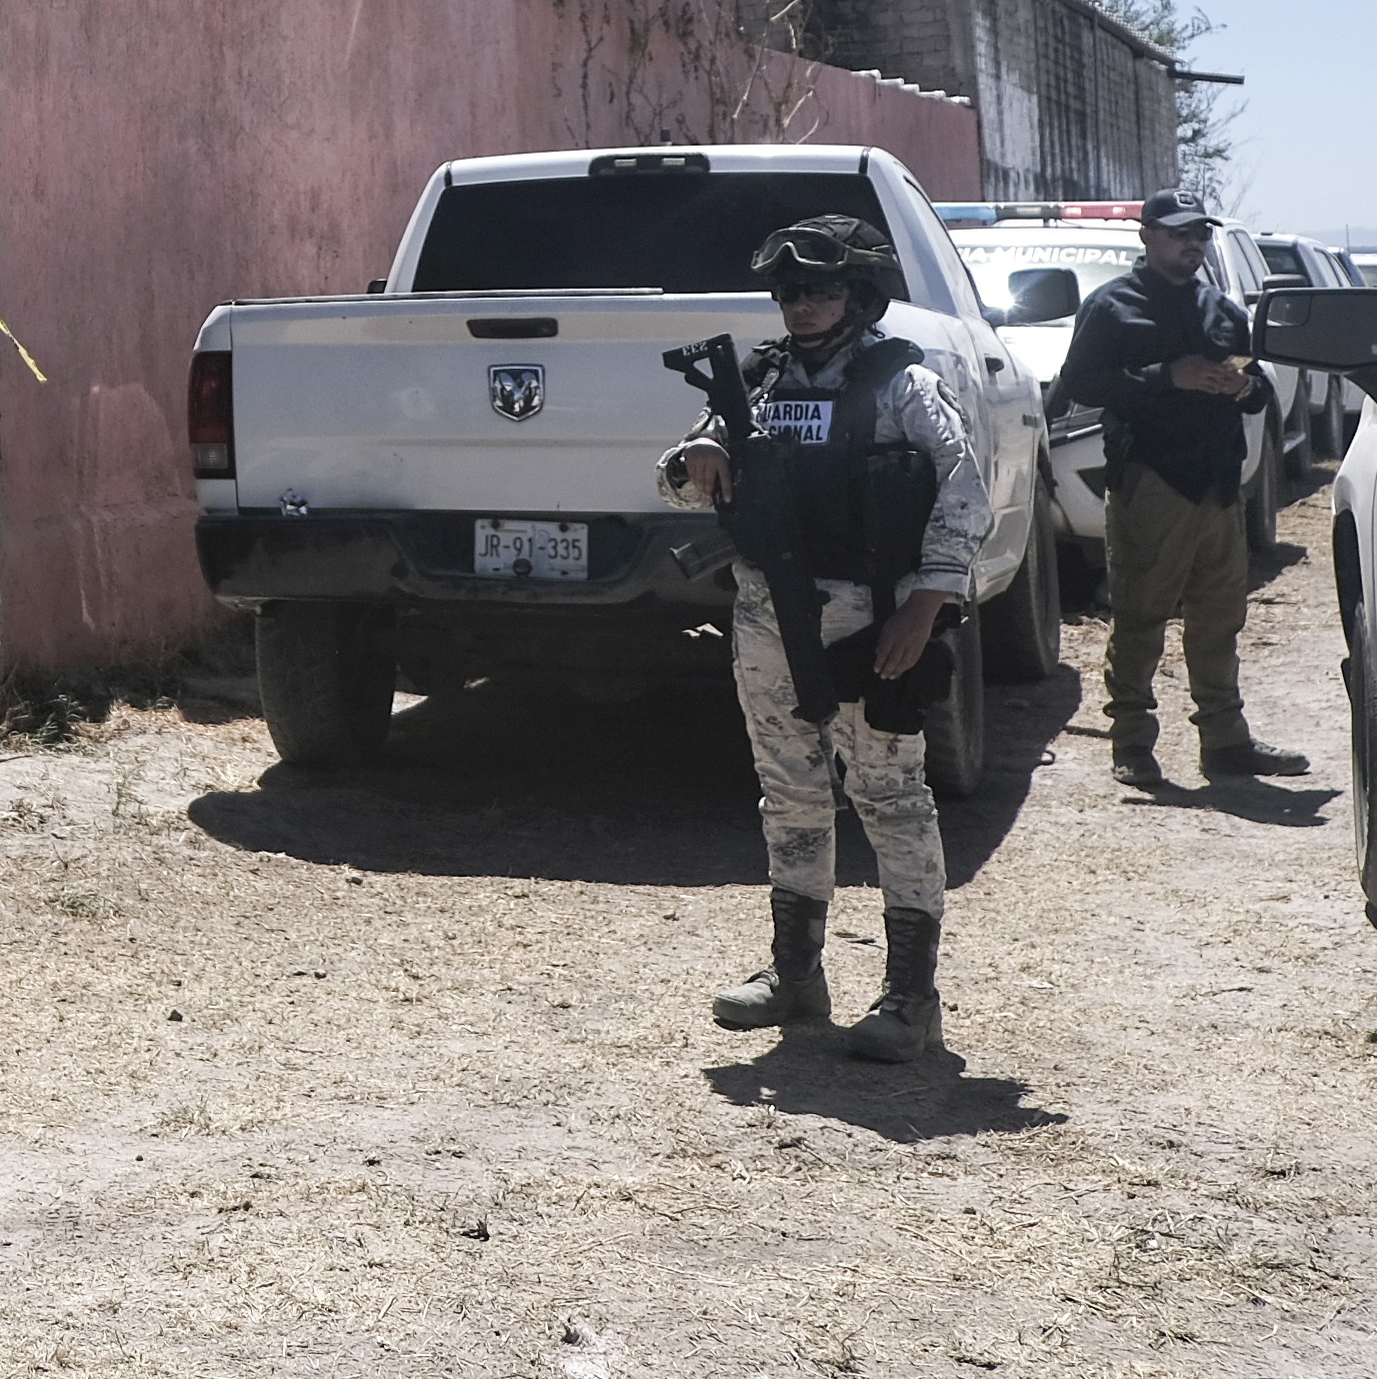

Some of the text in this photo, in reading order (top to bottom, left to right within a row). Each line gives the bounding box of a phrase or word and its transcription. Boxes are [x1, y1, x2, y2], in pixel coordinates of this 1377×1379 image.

[992, 246, 1133, 267] MUNICIPAL
[763, 403, 822, 422] UARDIA
[478, 534, 583, 561] JR-91-335
